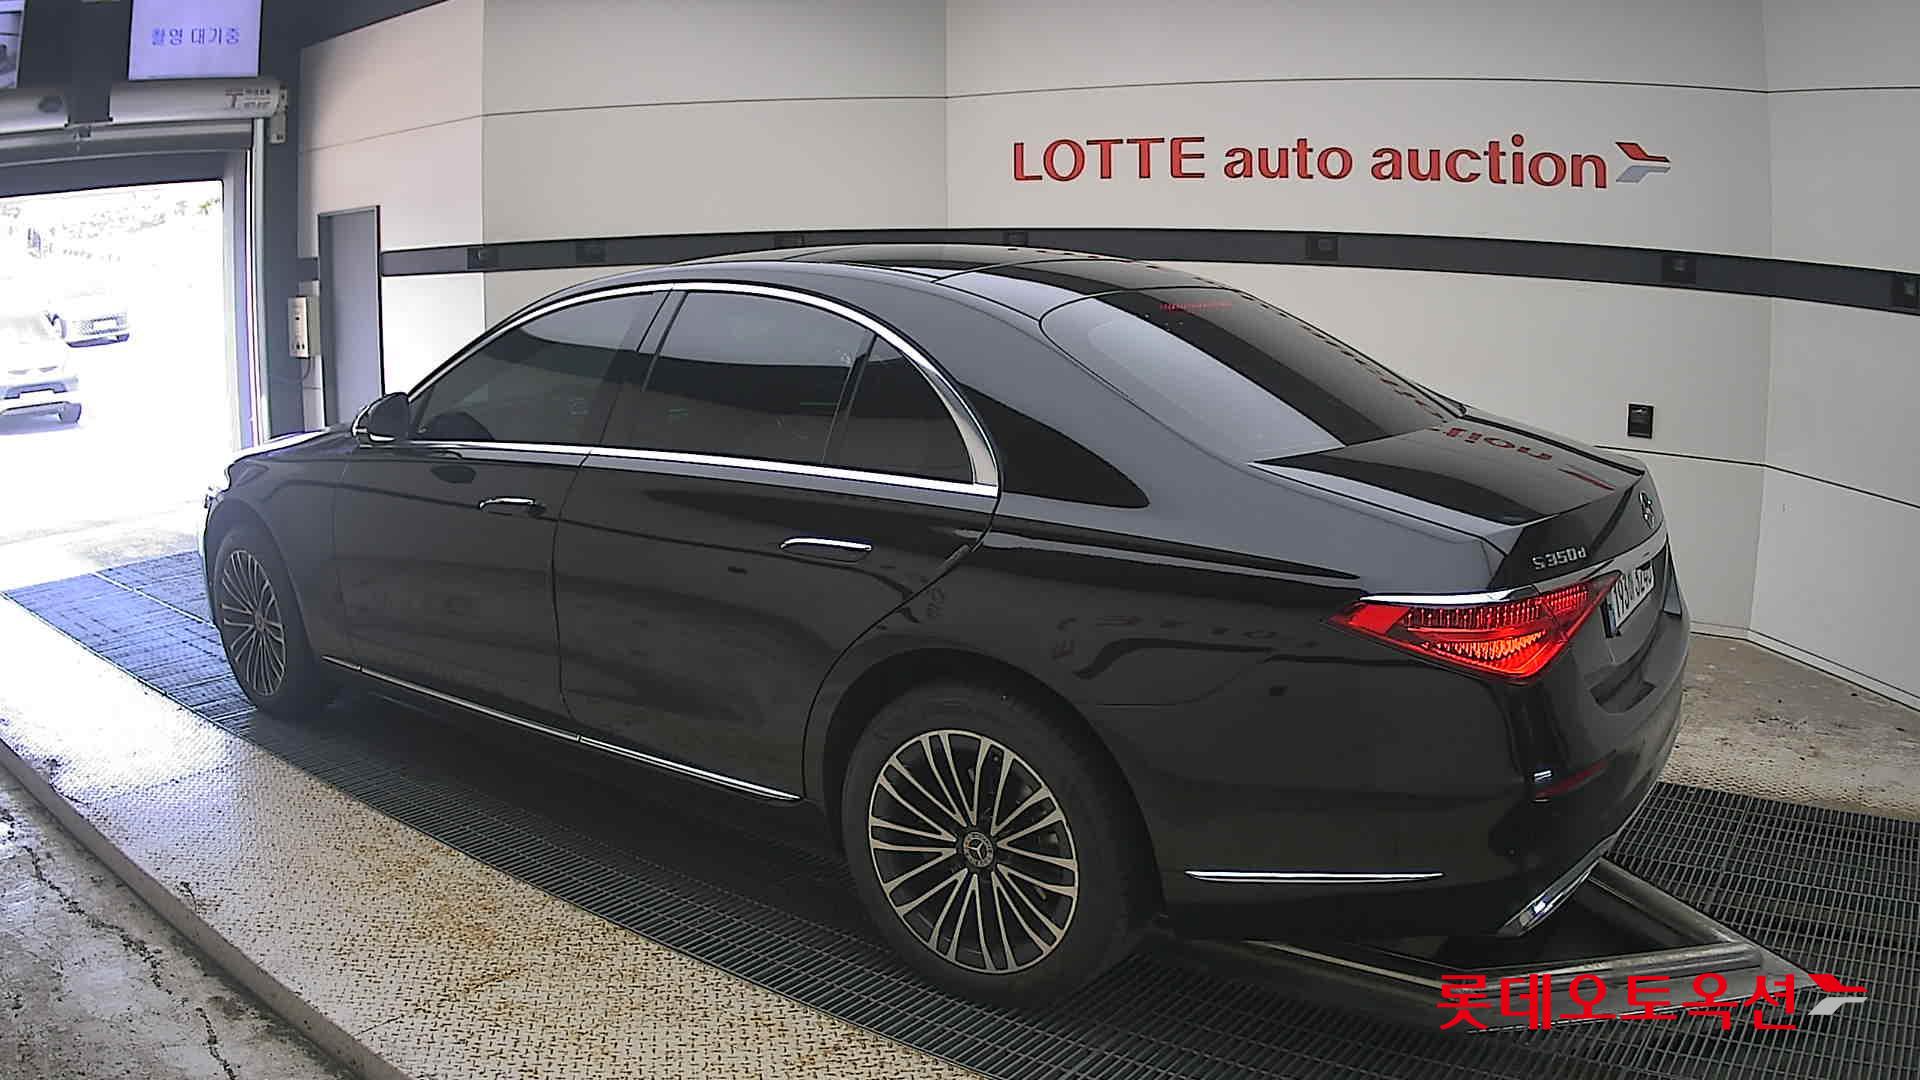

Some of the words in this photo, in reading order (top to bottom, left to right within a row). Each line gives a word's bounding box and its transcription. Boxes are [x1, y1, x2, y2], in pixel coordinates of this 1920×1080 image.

[191, 27, 240, 46] 대기중
[1013, 136, 1206, 182] LOTTE
[1223, 138, 1353, 180] auto
[1370, 134, 1607, 188] auction
